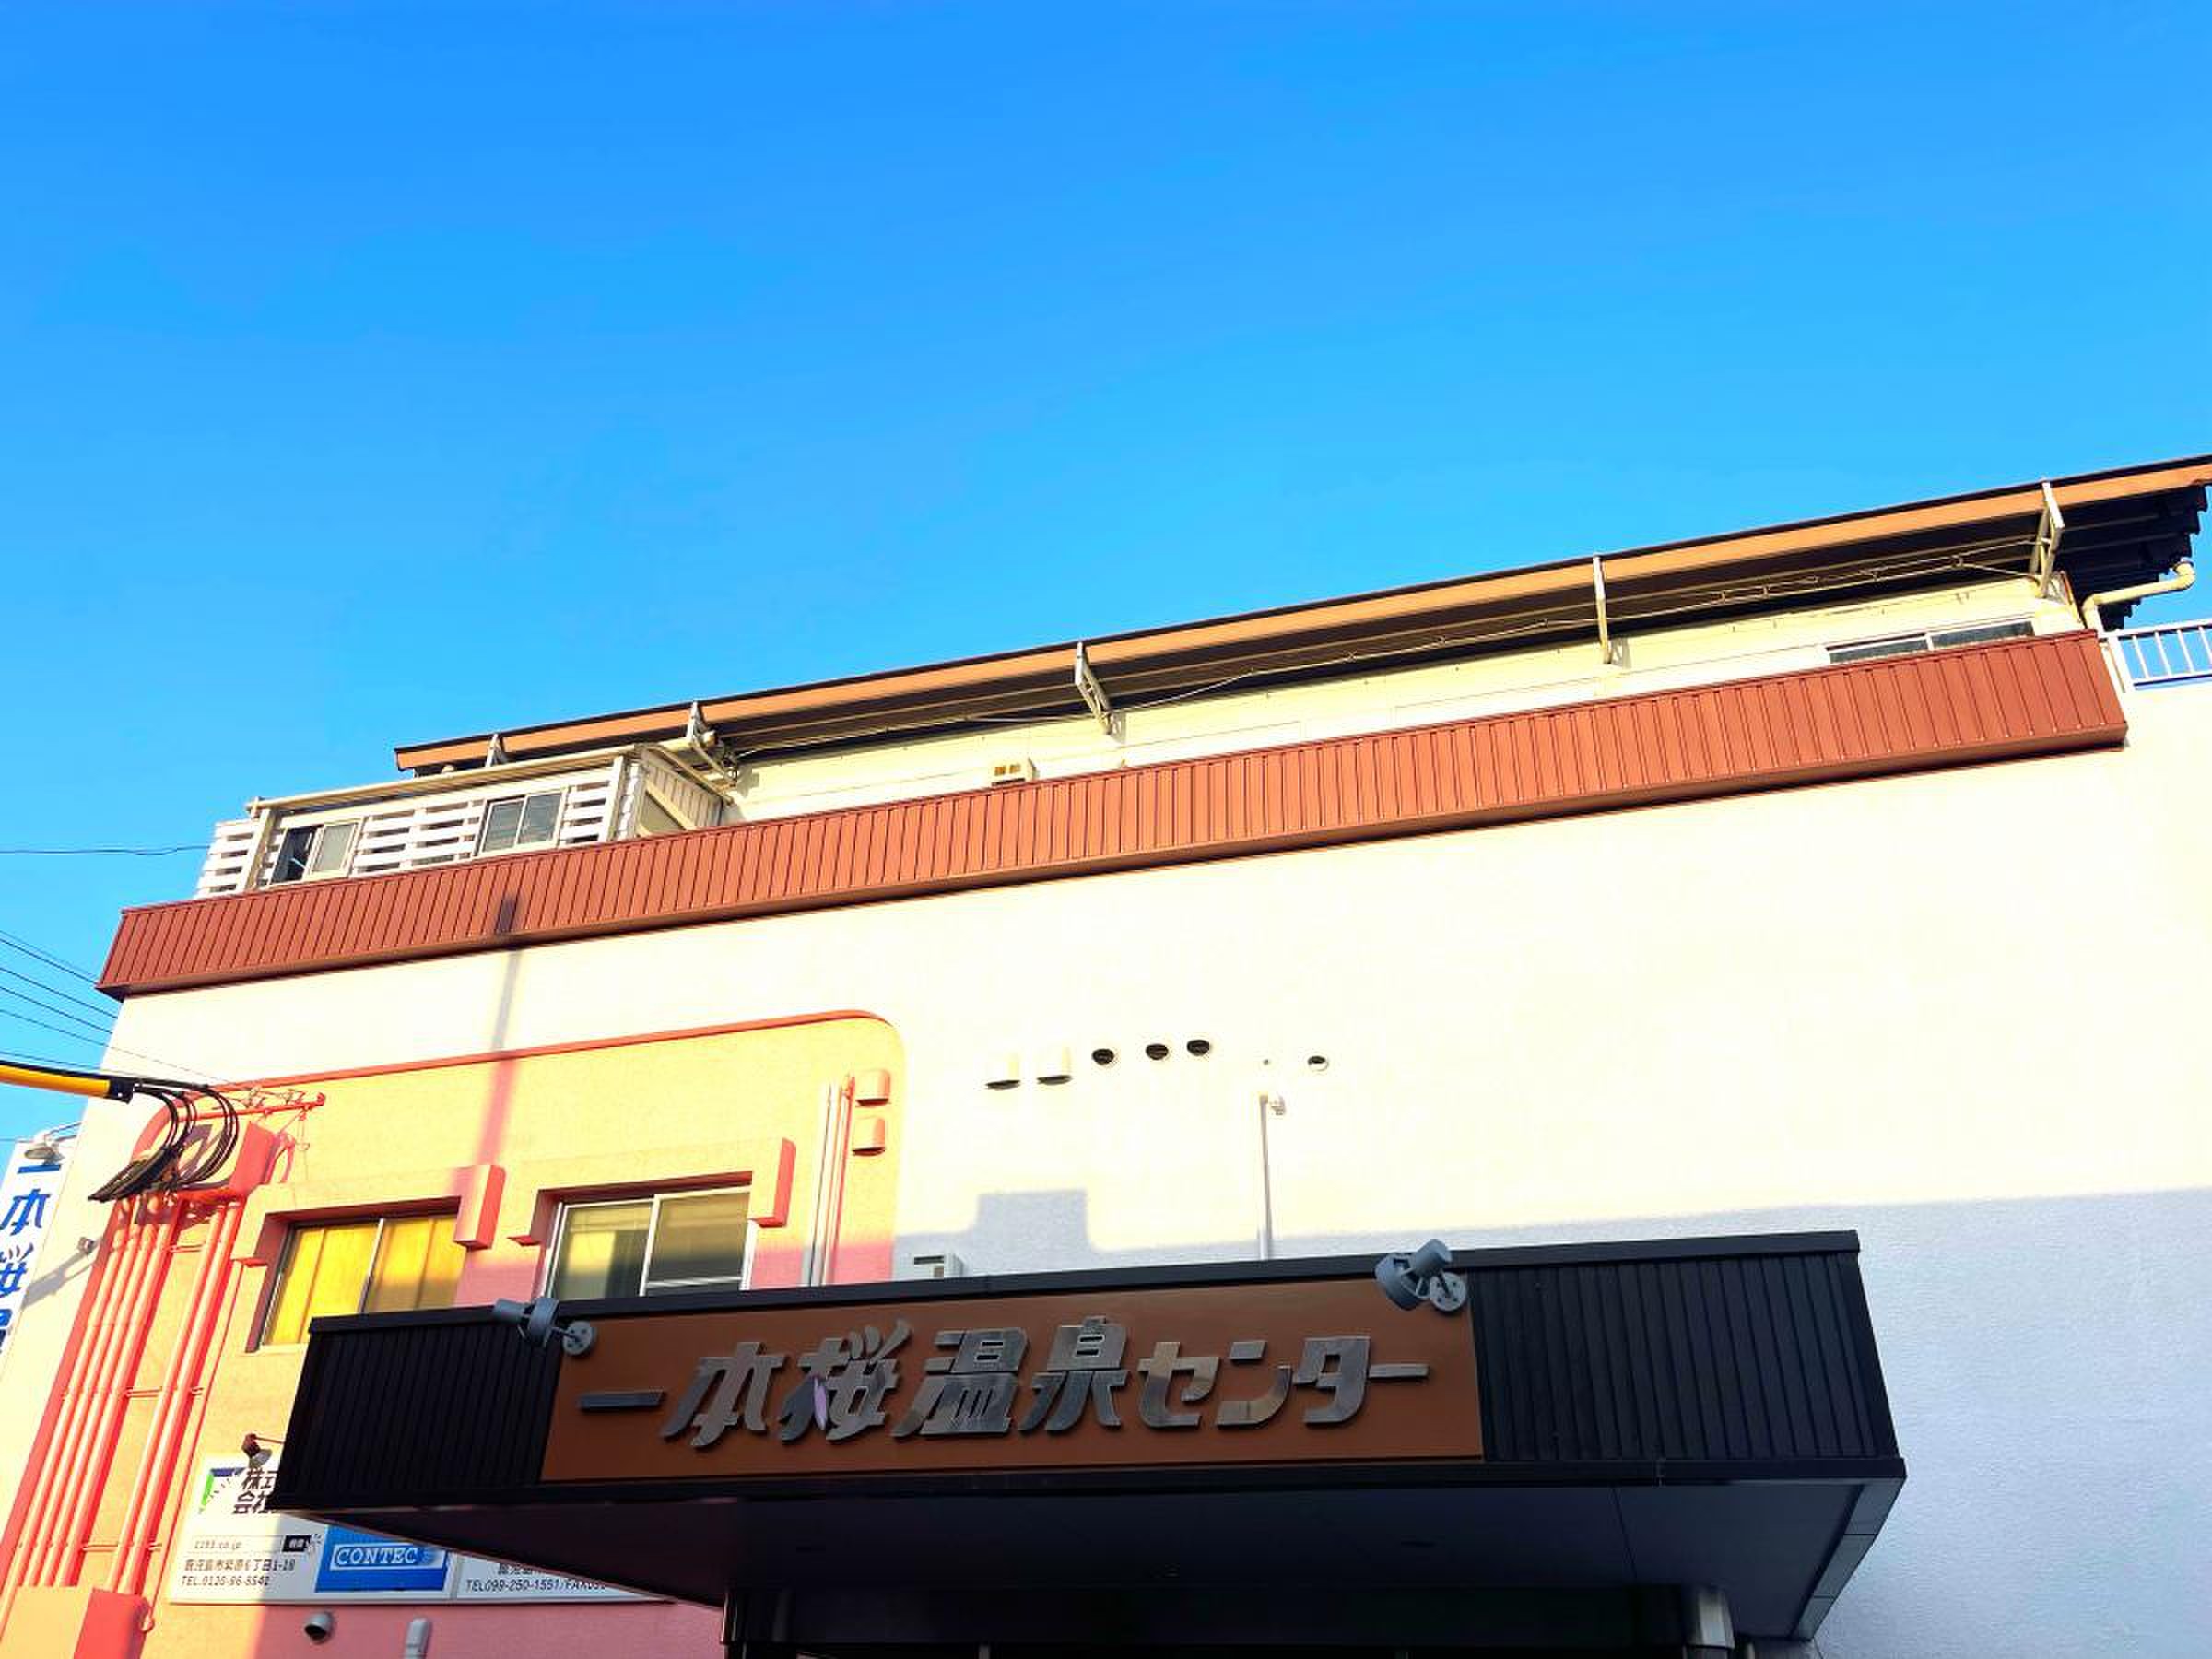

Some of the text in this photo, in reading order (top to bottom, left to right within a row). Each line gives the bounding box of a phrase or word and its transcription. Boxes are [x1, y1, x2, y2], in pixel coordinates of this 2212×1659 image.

[0, 1164, 61, 1354] 一本桜
[578, 1316, 1430, 1449] 一本桜温泉センター
[335, 1547, 419, 1565] CONTEC
